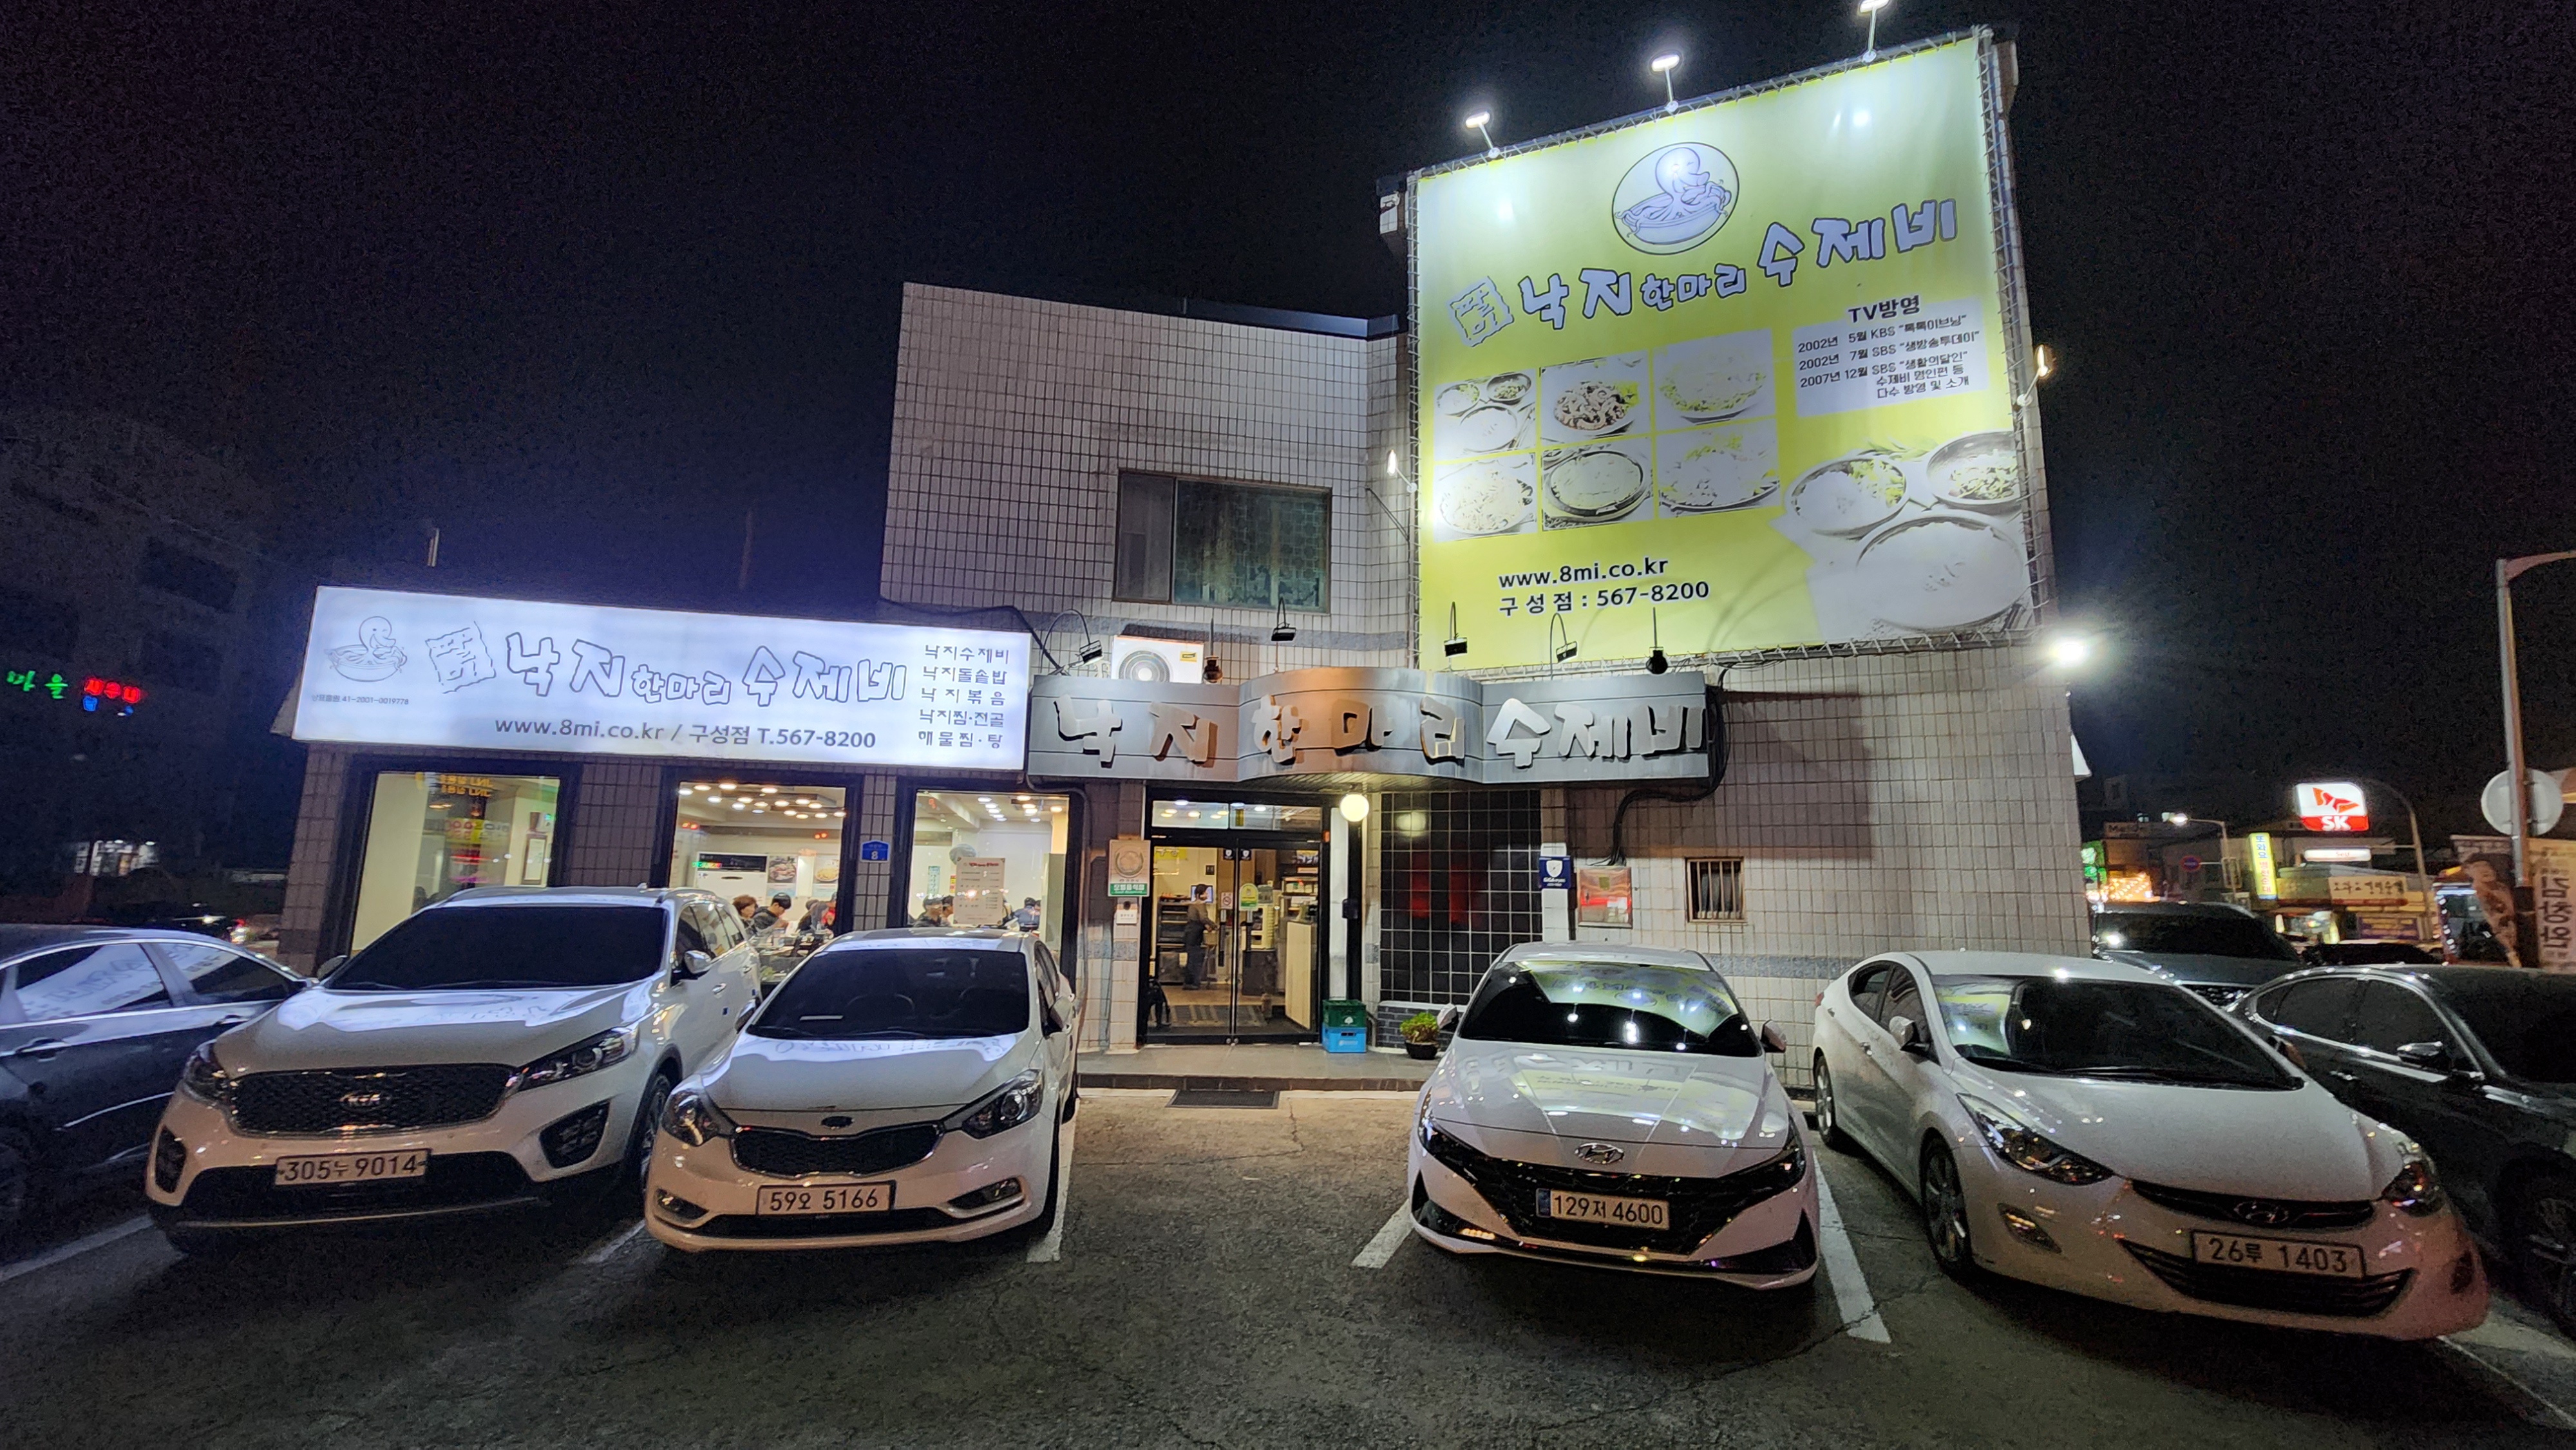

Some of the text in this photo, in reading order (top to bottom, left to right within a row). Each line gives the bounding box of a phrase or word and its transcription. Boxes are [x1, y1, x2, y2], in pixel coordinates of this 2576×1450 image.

[1517, 265, 1633, 330] 낙지
[1640, 263, 1747, 314] 한마리
[1757, 198, 1958, 288] 수제비
[1848, 294, 1920, 323] TV방영
[1798, 335, 1839, 353] 2002년
[1848, 330, 1868, 343] 5월
[1870, 326, 1896, 339] KBS
[1799, 353, 1839, 371] 2002년
[1850, 348, 1868, 361] 7월
[1871, 344, 1897, 357] SBS
[1800, 371, 1841, 388] 2007년
[1844, 366, 1868, 379] 12월
[1871, 362, 1897, 375] SBS
[1877, 372, 1910, 386] 수제비
[1953, 364, 1964, 375] 등
[1877, 376, 1969, 399] 다수 방영 및 소개
[1498, 558, 1669, 588] www.8mi.co.kr
[1499, 591, 1573, 616] 구성점
[1597, 581, 1709, 607] 567-8200
[925, 645, 1009, 664] 낙지수제비
[506, 632, 625, 697] 낙지
[630, 664, 732, 704] 한마리
[742, 645, 907, 707] 수제비
[923, 666, 1007, 685] 낙지돌솥밥
[342, 695, 409, 705] 41-2001-0019778
[495, 719, 663, 740] www.8mi.co.kr
[688, 724, 750, 746] 구성점
[757, 727, 876, 749] T.567-8200
[1054, 694, 1707, 769] 낙지 한마리 수제비
[2320, 816, 2351, 831] SK
[871, 851, 878, 860] 8
[285, 1154, 417, 1181] 305누 9014
[770, 1189, 878, 1211] 59오 5166
[1612, 1201, 1663, 1225] 4600
[2208, 1238, 2347, 1272] 26루 1403
